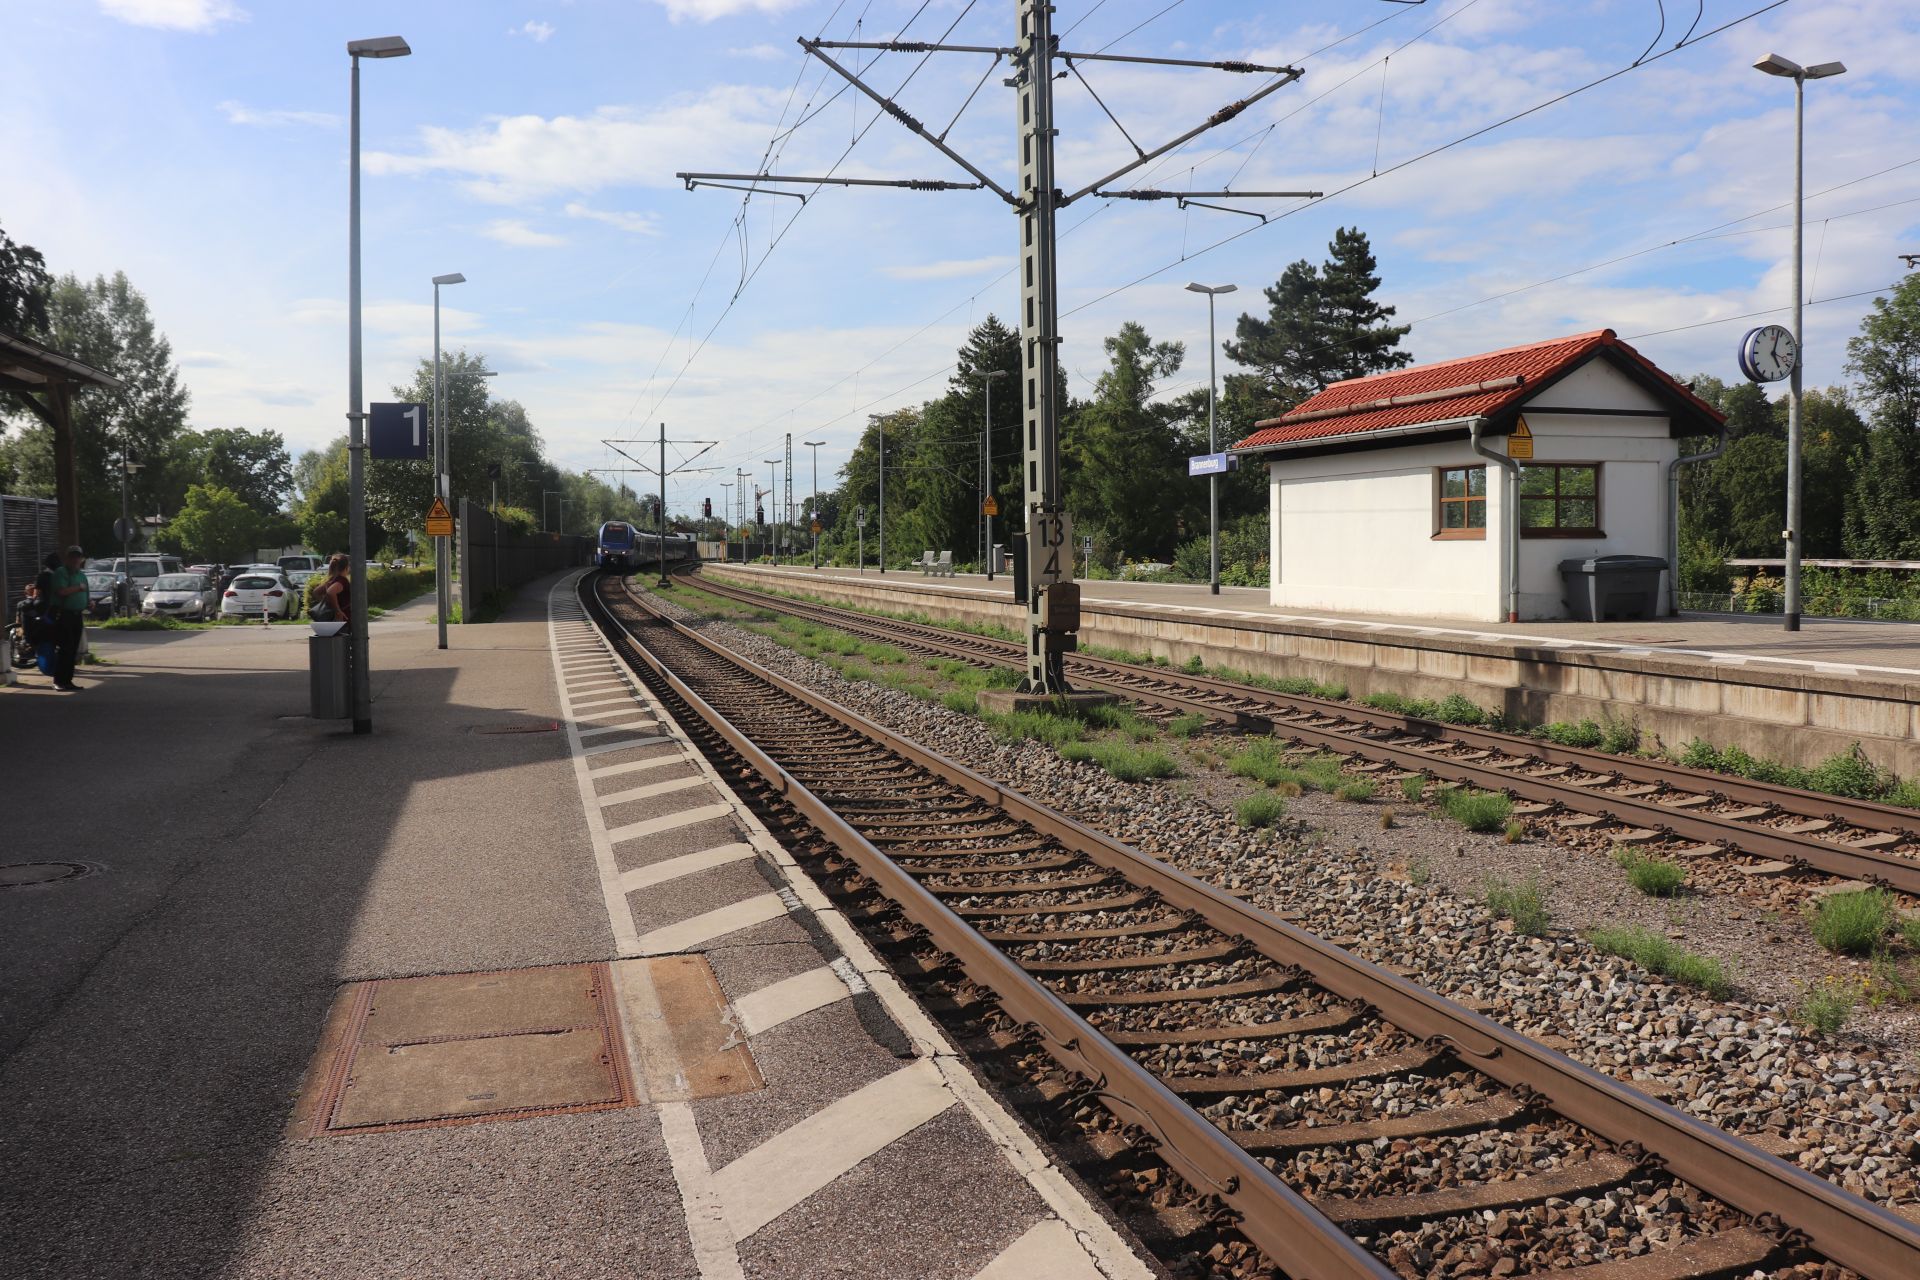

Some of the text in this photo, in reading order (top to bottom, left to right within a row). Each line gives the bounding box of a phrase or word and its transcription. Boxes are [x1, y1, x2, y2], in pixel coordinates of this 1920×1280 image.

[403, 406, 419, 446] 1
[1038, 518, 1065, 547] 13
[1085, 537, 1091, 547] H
[1043, 550, 1062, 579] 4
